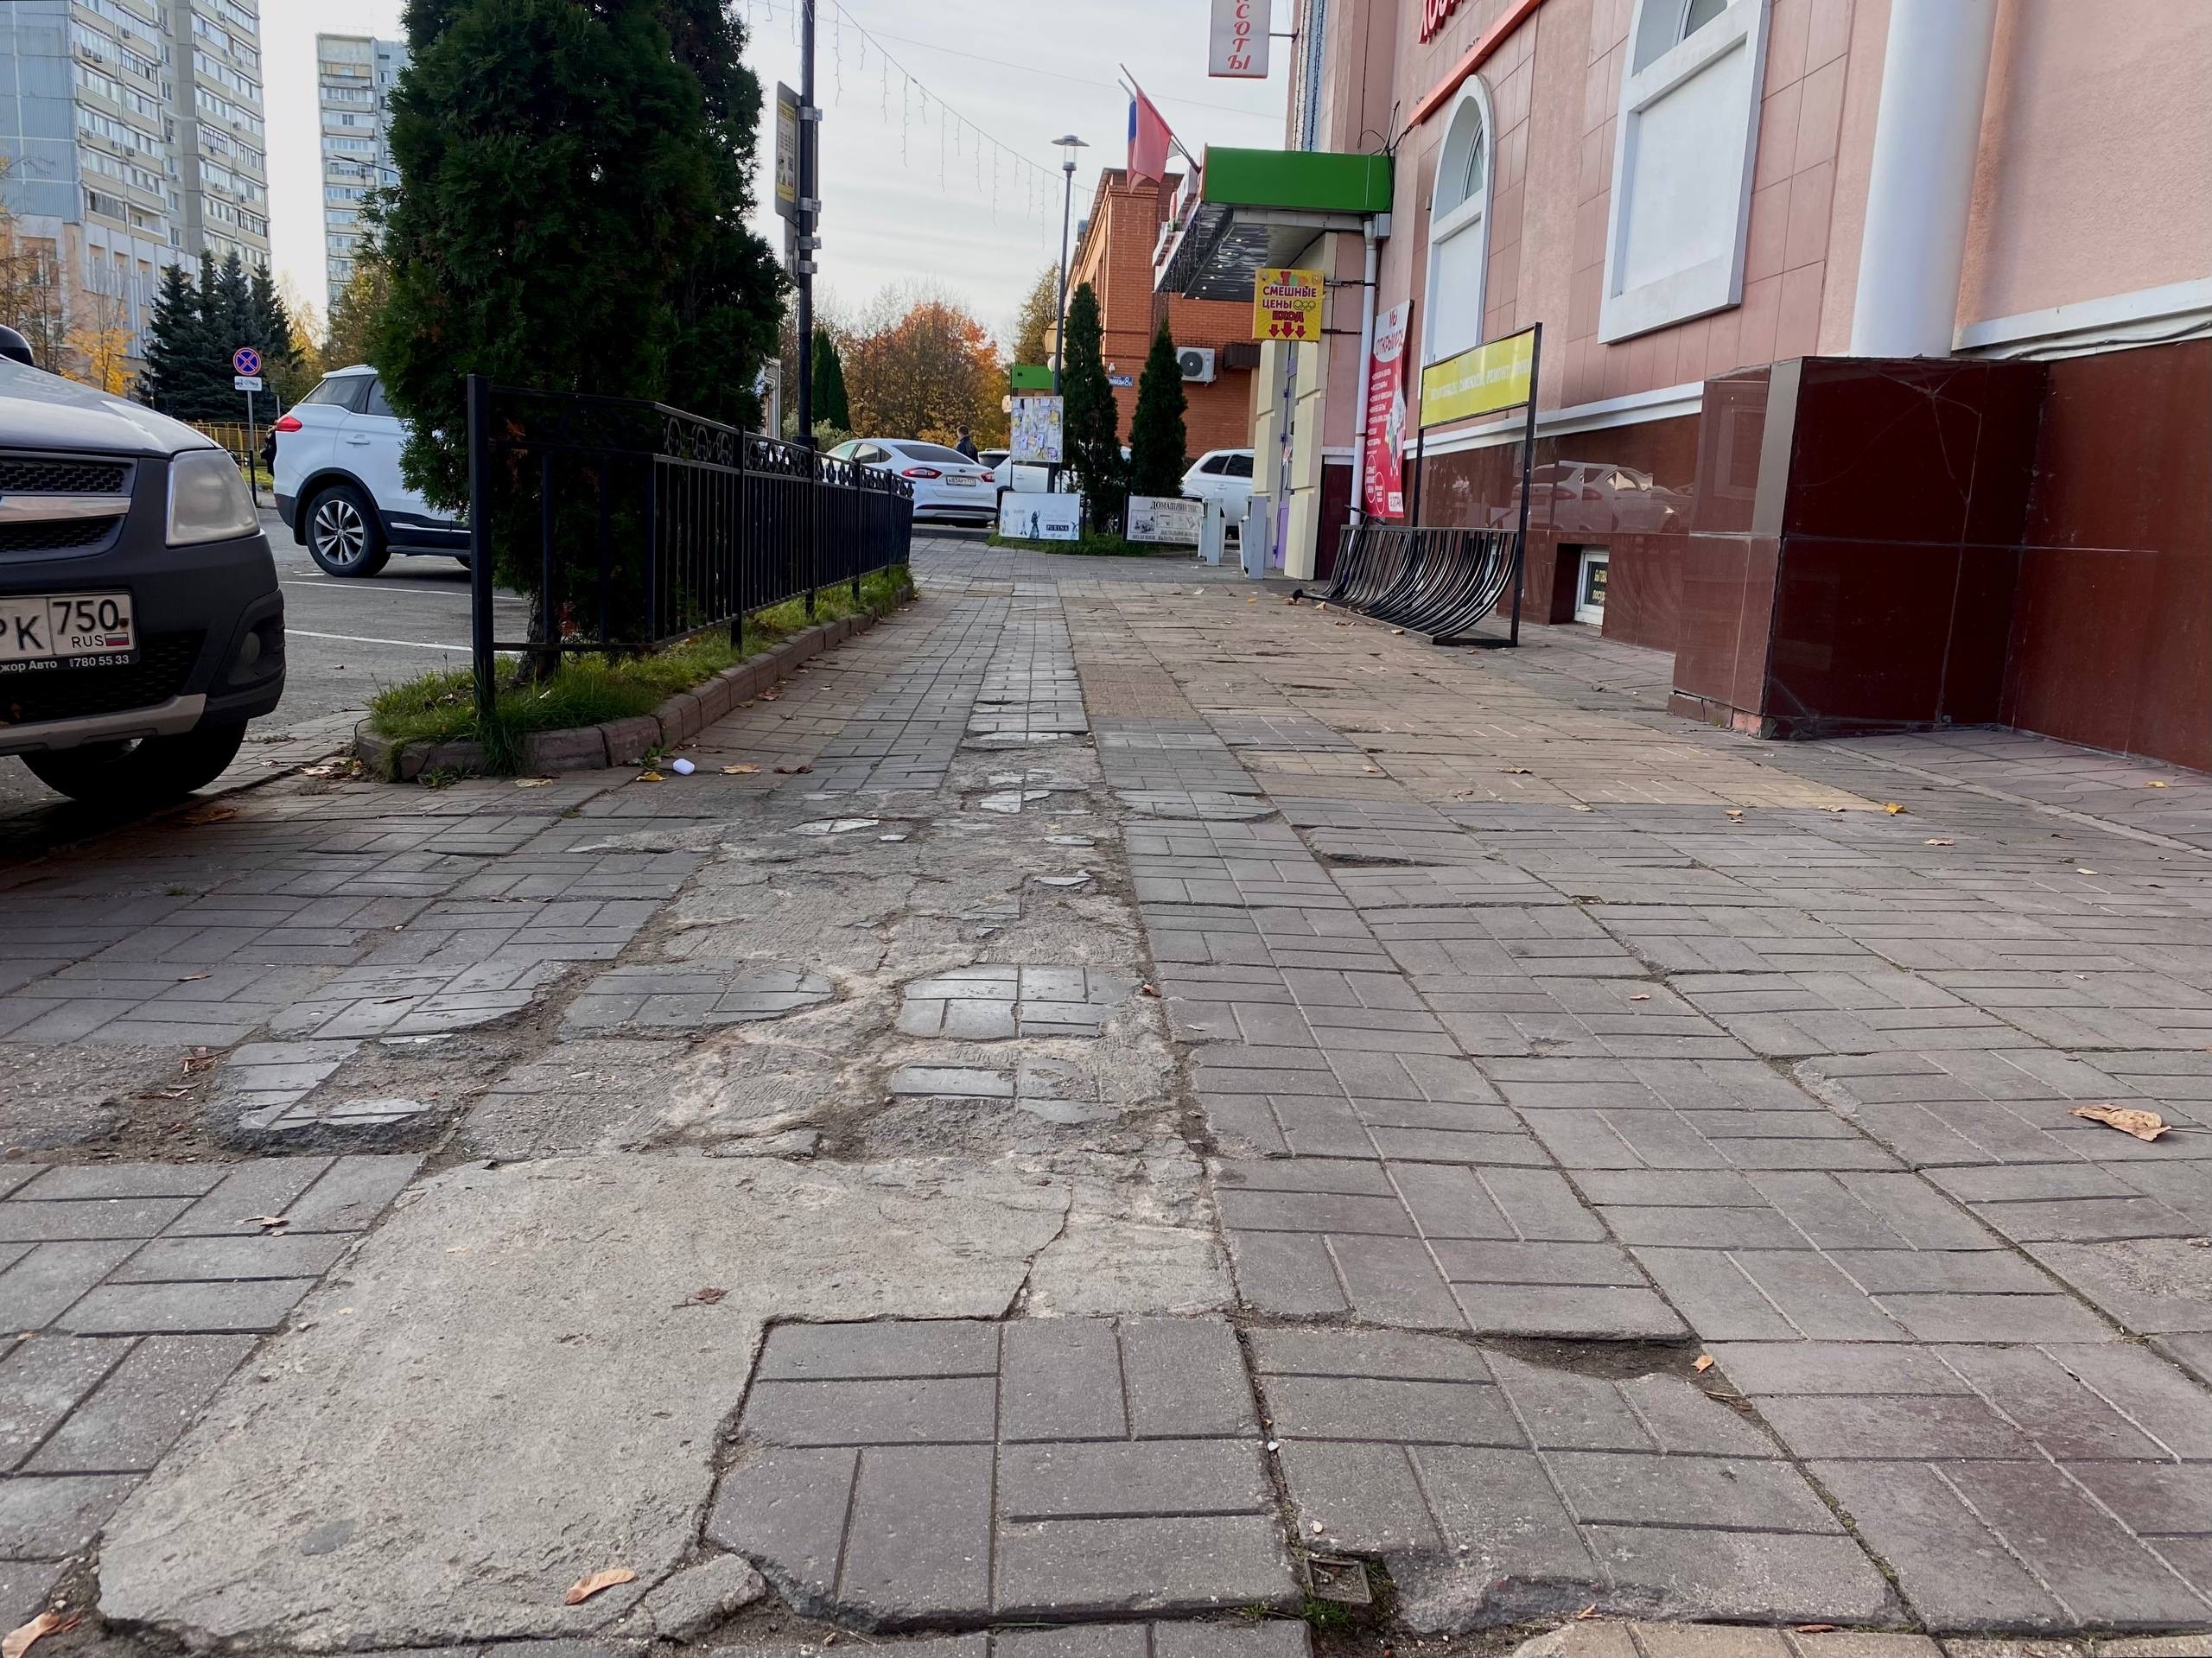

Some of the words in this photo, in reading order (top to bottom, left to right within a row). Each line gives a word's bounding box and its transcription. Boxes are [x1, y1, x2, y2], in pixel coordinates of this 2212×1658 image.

[1228, 0, 1251, 70] СОТЫ
[1262, 286, 1317, 297] СМЕШНЫЕ
[1262, 299, 1292, 309] ЦЕНЫ
[1272, 310, 1304, 323] ВХОД
[52, 599, 119, 636] 750
[71, 634, 105, 649] RUS
[29, 659, 58, 670] Авто
[73, 657, 96, 668] 780
[99, 656, 112, 666] 55
[115, 654, 129, 664] 33
